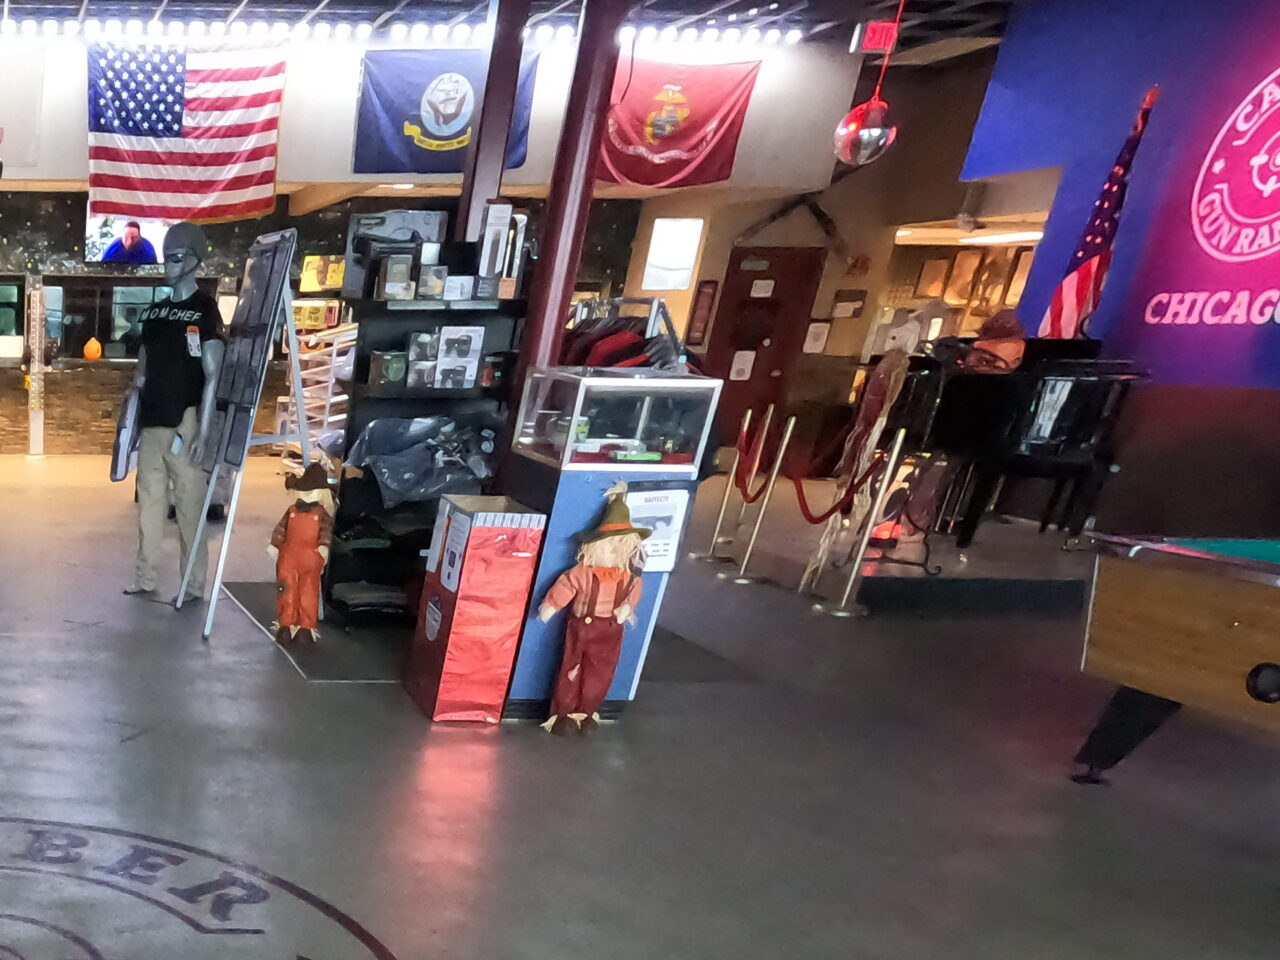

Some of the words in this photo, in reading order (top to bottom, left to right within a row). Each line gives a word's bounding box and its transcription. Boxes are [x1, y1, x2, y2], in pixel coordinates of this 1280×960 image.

[1199, 192, 1241, 250] GUN
[169, 308, 203, 322] CHEF
[1143, 288, 1280, 325] CHICAG
